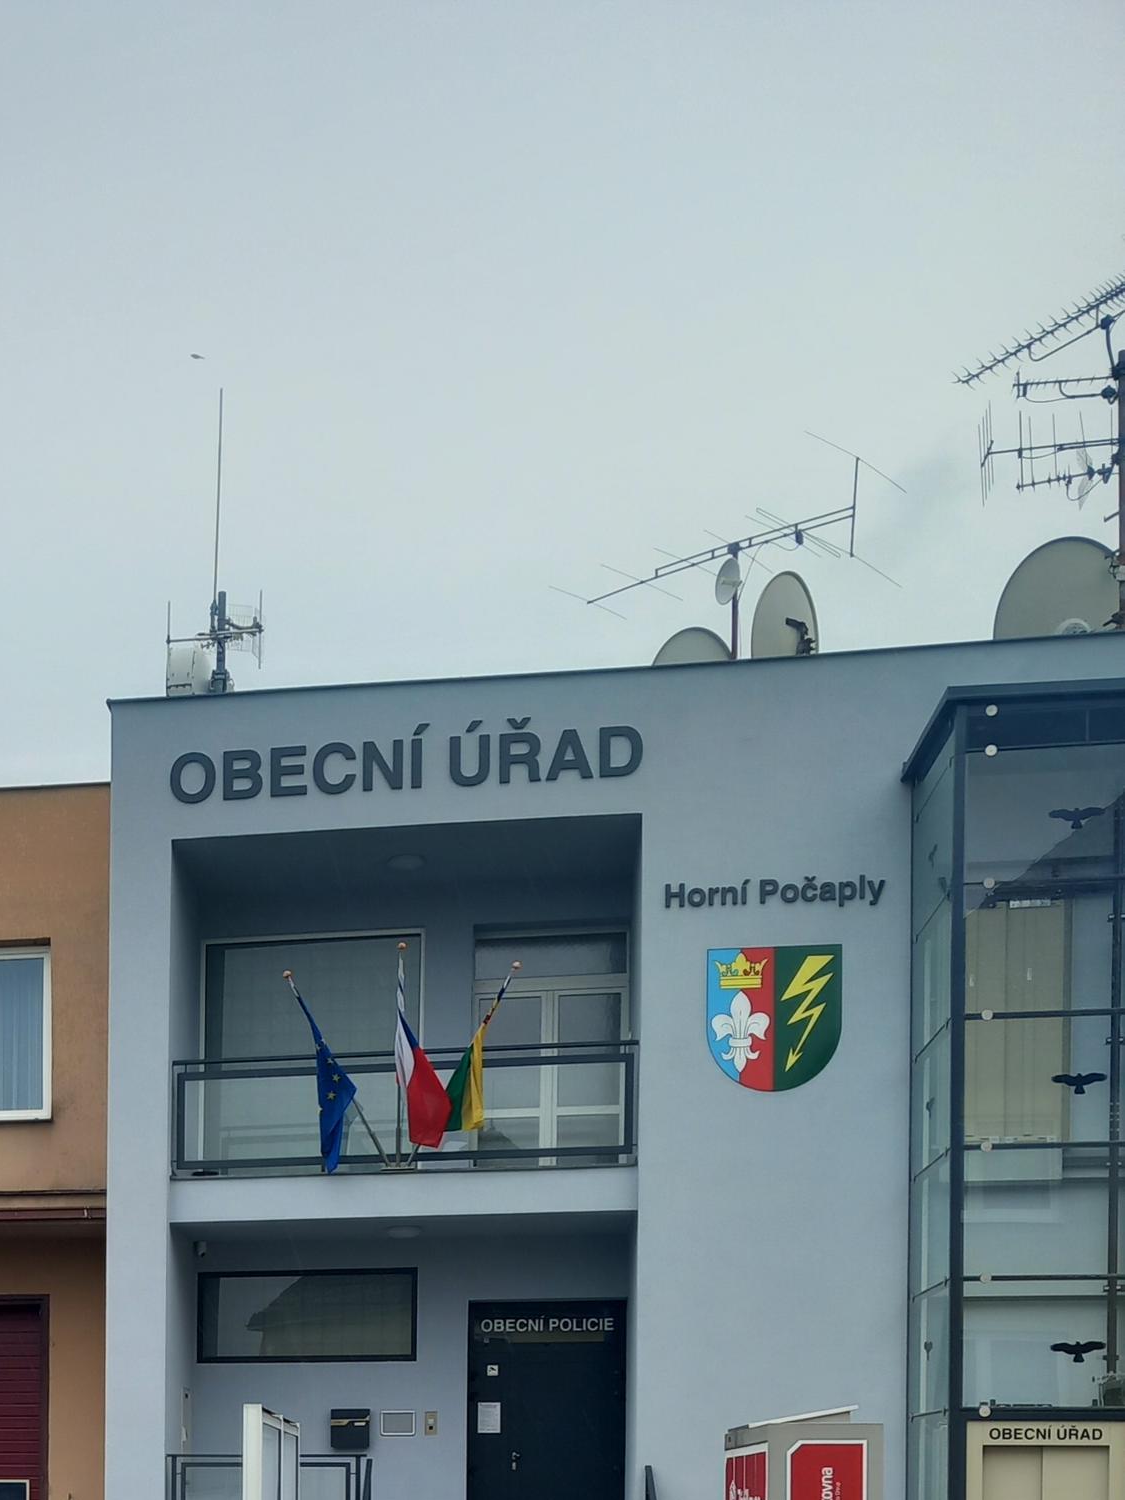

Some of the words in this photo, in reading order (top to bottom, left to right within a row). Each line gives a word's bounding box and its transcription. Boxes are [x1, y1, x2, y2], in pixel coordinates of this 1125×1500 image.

[170, 723, 430, 804] OBECNÍ
[449, 717, 643, 787] ÚŘAD
[665, 879, 751, 908] Horní
[759, 874, 886, 907] Počaply
[481, 1315, 544, 1332] OBECNÍ
[549, 1318, 614, 1331] POLICIE
[989, 1425, 1052, 1440] OBECNÍ
[1057, 1425, 1103, 1440] ÚŘAD
